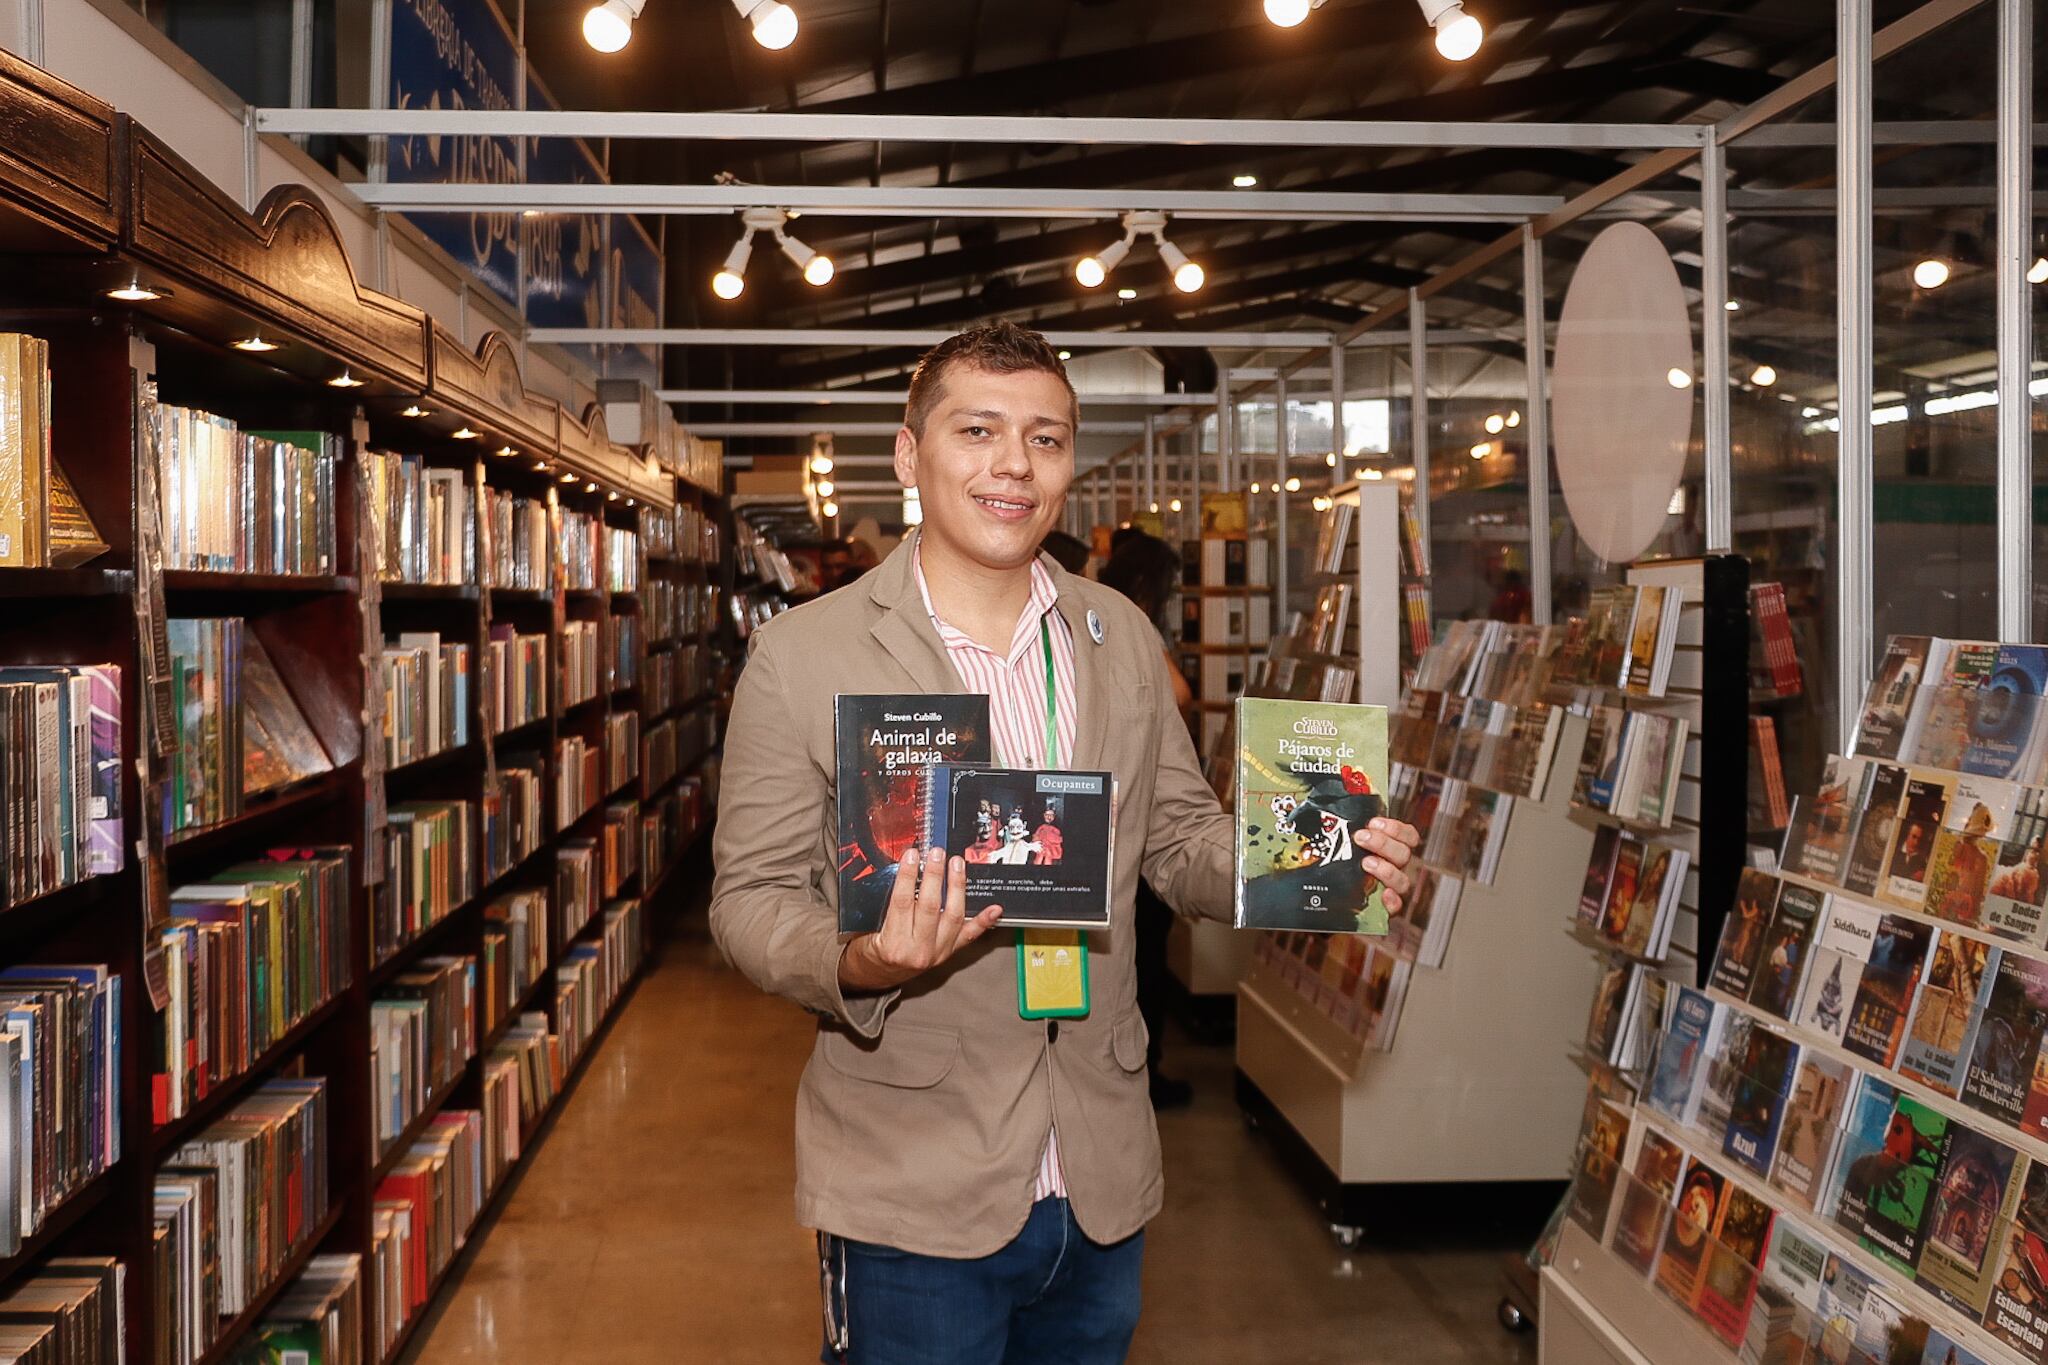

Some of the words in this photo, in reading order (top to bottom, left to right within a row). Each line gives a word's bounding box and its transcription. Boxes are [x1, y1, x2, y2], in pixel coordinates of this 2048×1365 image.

[883, 711, 912, 721] Steven
[913, 711, 943, 721] Cubillo
[1302, 716, 1335, 728] STEVEN
[870, 726, 930, 746] Animal
[935, 727, 957, 746] de
[1293, 720, 1338, 737] CUBILLO
[885, 746, 943, 769] galaxia
[1278, 739, 1332, 760] Pájaros
[1336, 743, 1355, 759] de
[1290, 757, 1341, 774] ciudad
[1041, 778, 1096, 791] Ocupantes
[2011, 902, 2042, 920] Bodas
[1832, 917, 1872, 941] Siddharta
[1989, 911, 2001, 923] de
[2003, 914, 2038, 934] Sangre
[1969, 1065, 1979, 1079] El
[1980, 1071, 2013, 1095] Sabueso
[2013, 1084, 2025, 1100] de
[1966, 1078, 1978, 1094] los
[1978, 1084, 2024, 1115] Baskerville
[1904, 1233, 1914, 1248] La
[1995, 1290, 2033, 1324] Estudio
[1996, 1309, 2044, 1351] Escarlata
